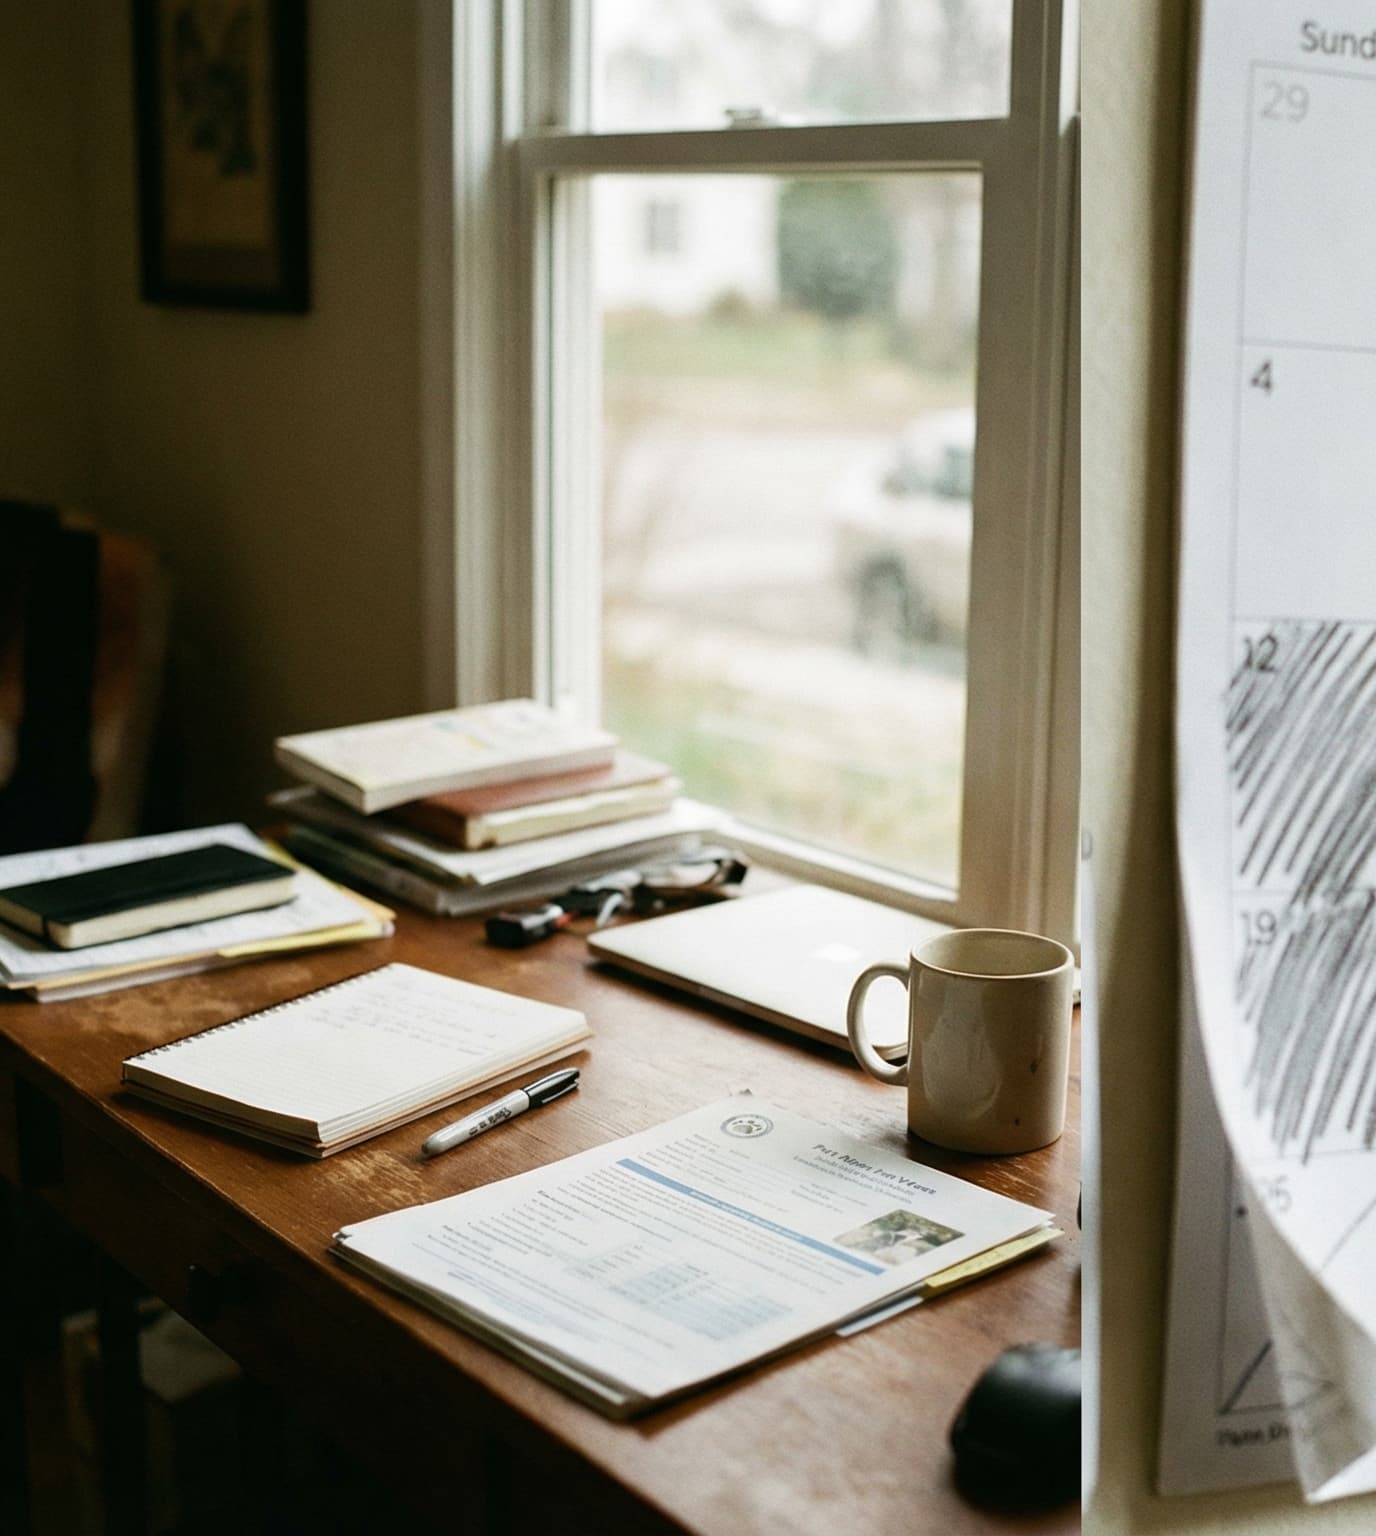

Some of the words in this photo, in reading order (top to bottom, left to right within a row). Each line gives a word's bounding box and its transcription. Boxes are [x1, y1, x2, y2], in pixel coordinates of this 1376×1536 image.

[1260, 81, 1310, 122] 29
[1250, 359, 1274, 397] 4
[1243, 633, 1279, 672] 12
